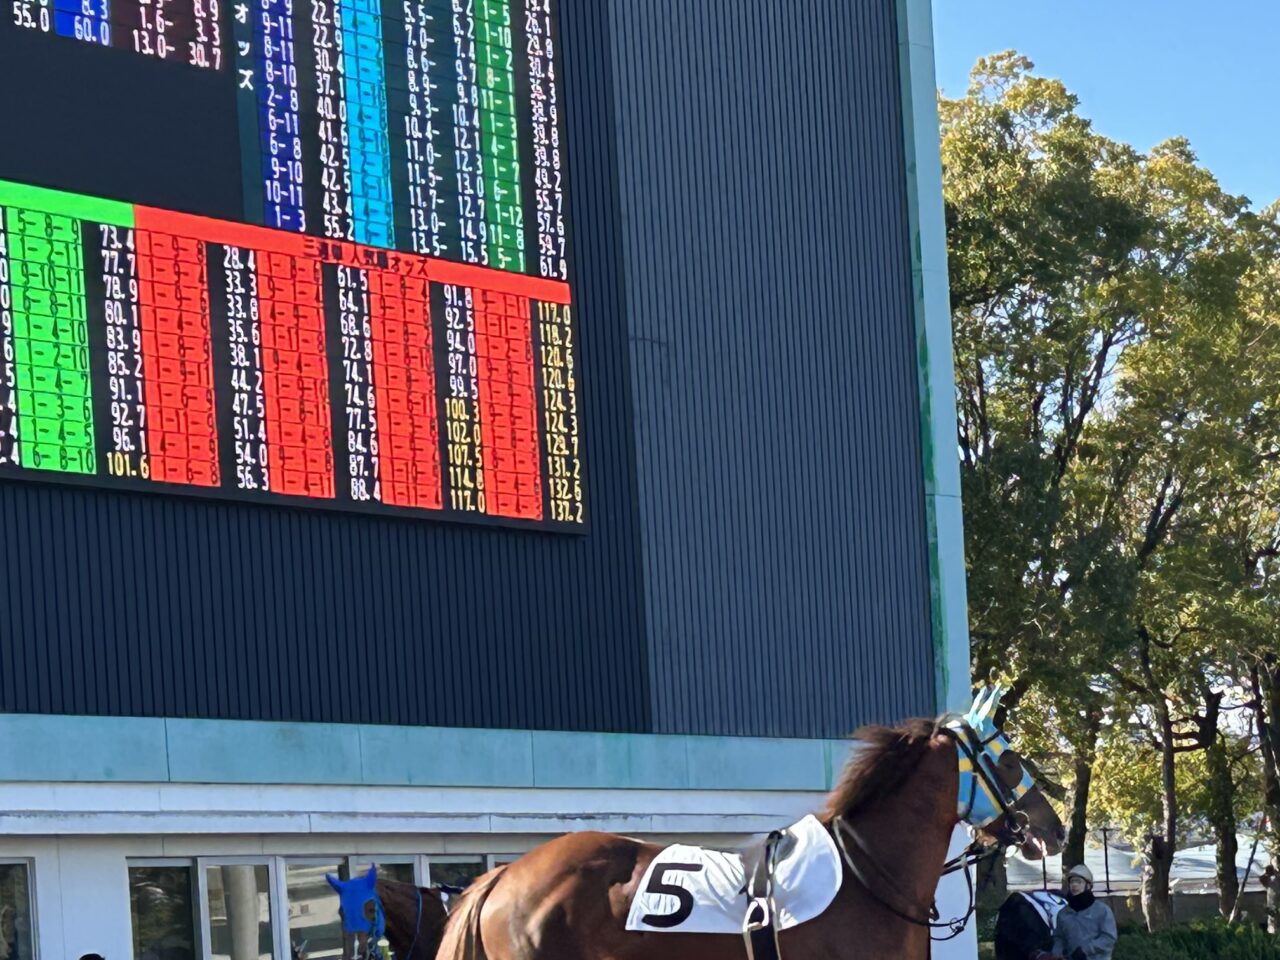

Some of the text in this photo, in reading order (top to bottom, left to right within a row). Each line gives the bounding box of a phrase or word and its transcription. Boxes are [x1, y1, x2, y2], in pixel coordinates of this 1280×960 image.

[13, 1, 49, 32] 55.0
[311, 1, 340, 28] 22.6
[75, 16, 108, 46] 60.0
[313, 25, 342, 51] 22.9
[189, 42, 221, 70] 30.7
[314, 48, 344, 75] 30.4
[316, 72, 345, 99] 37.1
[317, 96, 347, 122] 40.0
[319, 120, 348, 146] 41.6
[320, 143, 350, 170] 42.5
[322, 167, 351, 193] 42.5
[323, 191, 353, 217] 43.4
[100, 224, 134, 250] 73.4
[324, 214, 354, 241] 55.2
[101, 250, 136, 276] 77.7
[224, 246, 255, 271] 28.4
[103, 275, 137, 301] 78.9
[225, 270, 256, 295] 33.3
[338, 266, 368, 290] 61.5
[227, 295, 258, 320] 33.8
[339, 289, 369, 314] 64.1
[444, 285, 472, 308] 91.8
[104, 300, 139, 326] 80.1
[341, 312, 371, 337] 68.6
[446, 307, 473, 331] 92.5
[106, 325, 141, 352] 83.9
[228, 320, 260, 344] 35.6
[447, 330, 475, 354] 94.0
[230, 344, 261, 368] 38.1
[342, 336, 372, 360] 72.8
[107, 351, 143, 377] 85.2
[344, 359, 374, 384] 74.1
[448, 353, 476, 377] 97.0
[109, 376, 144, 402] 91.1
[231, 369, 263, 393] 44.2
[450, 376, 478, 400] 99.5
[233, 394, 264, 417] 47.5
[345, 383, 375, 407] 74.6
[110, 401, 146, 428] 92.7
[347, 406, 377, 431] 77.5
[445, 398, 479, 422] 100.3
[112, 427, 148, 453] 96.1
[234, 419, 266, 442] 51.4
[348, 429, 378, 454] 84.6
[446, 421, 480, 445] 102.0
[107, 452, 149, 478] 101.6
[236, 443, 267, 466] 54.0
[350, 453, 380, 477] 87.7
[448, 444, 482, 468] 107.5
[237, 468, 269, 490] 56.3
[351, 476, 381, 501] 88.4
[449, 466, 483, 491] 114.8
[451, 489, 485, 514] 117.0
[642, 863, 703, 928] 5
